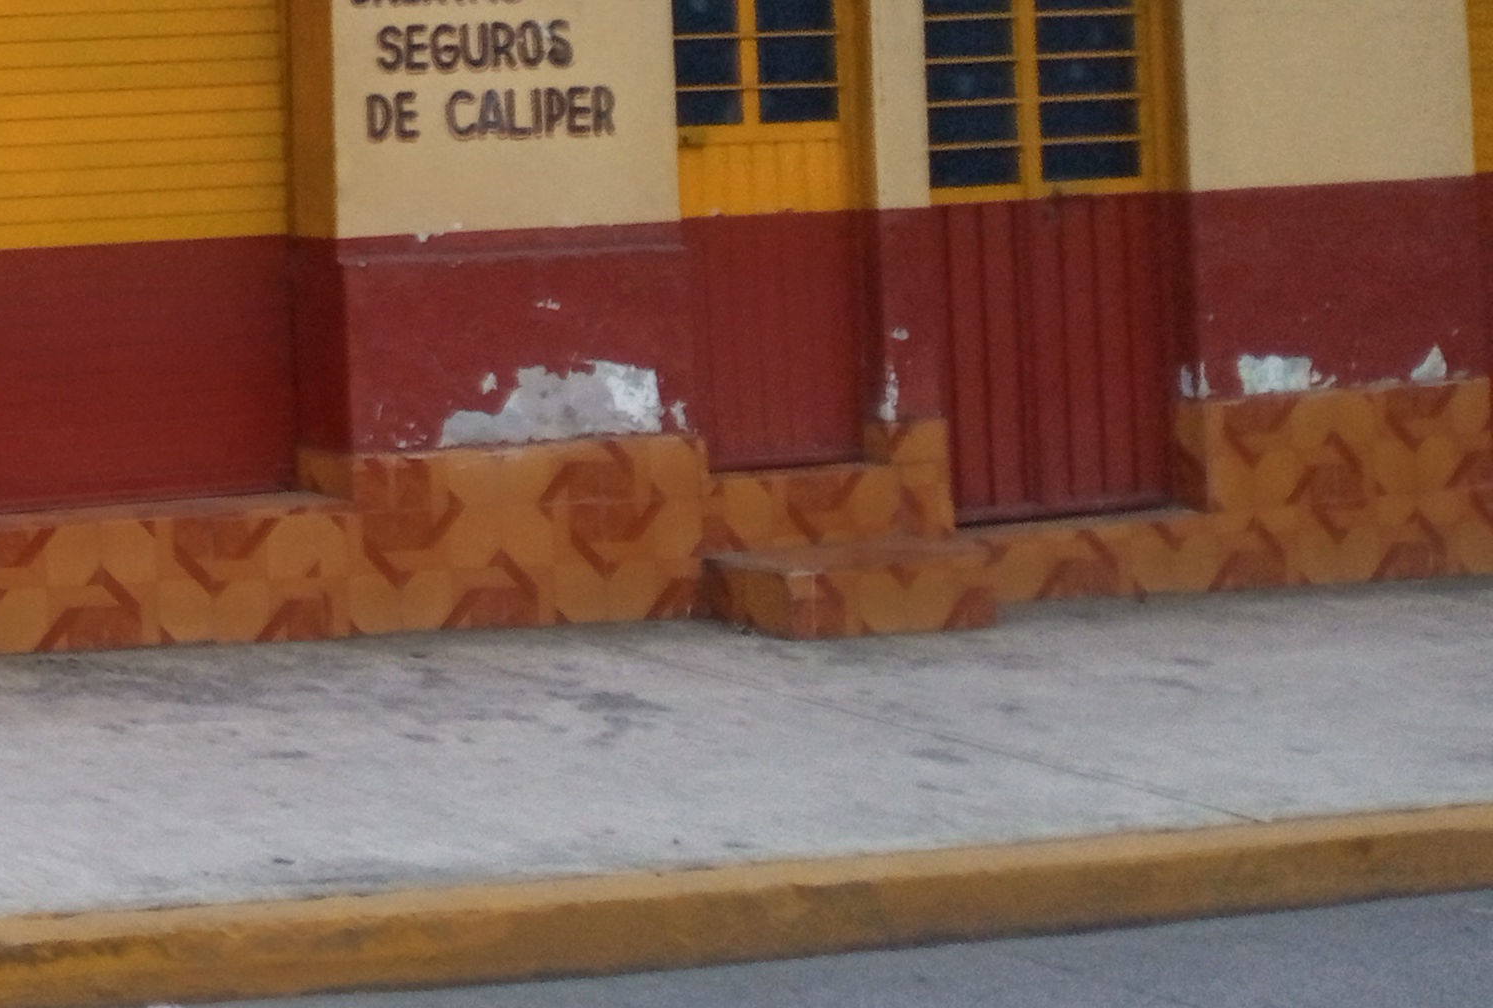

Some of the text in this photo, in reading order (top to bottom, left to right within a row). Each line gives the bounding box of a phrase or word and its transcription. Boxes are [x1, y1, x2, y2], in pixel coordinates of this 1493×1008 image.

[377, 19, 575, 72] SEGUROS
[366, 86, 616, 143] DE CALIPER
